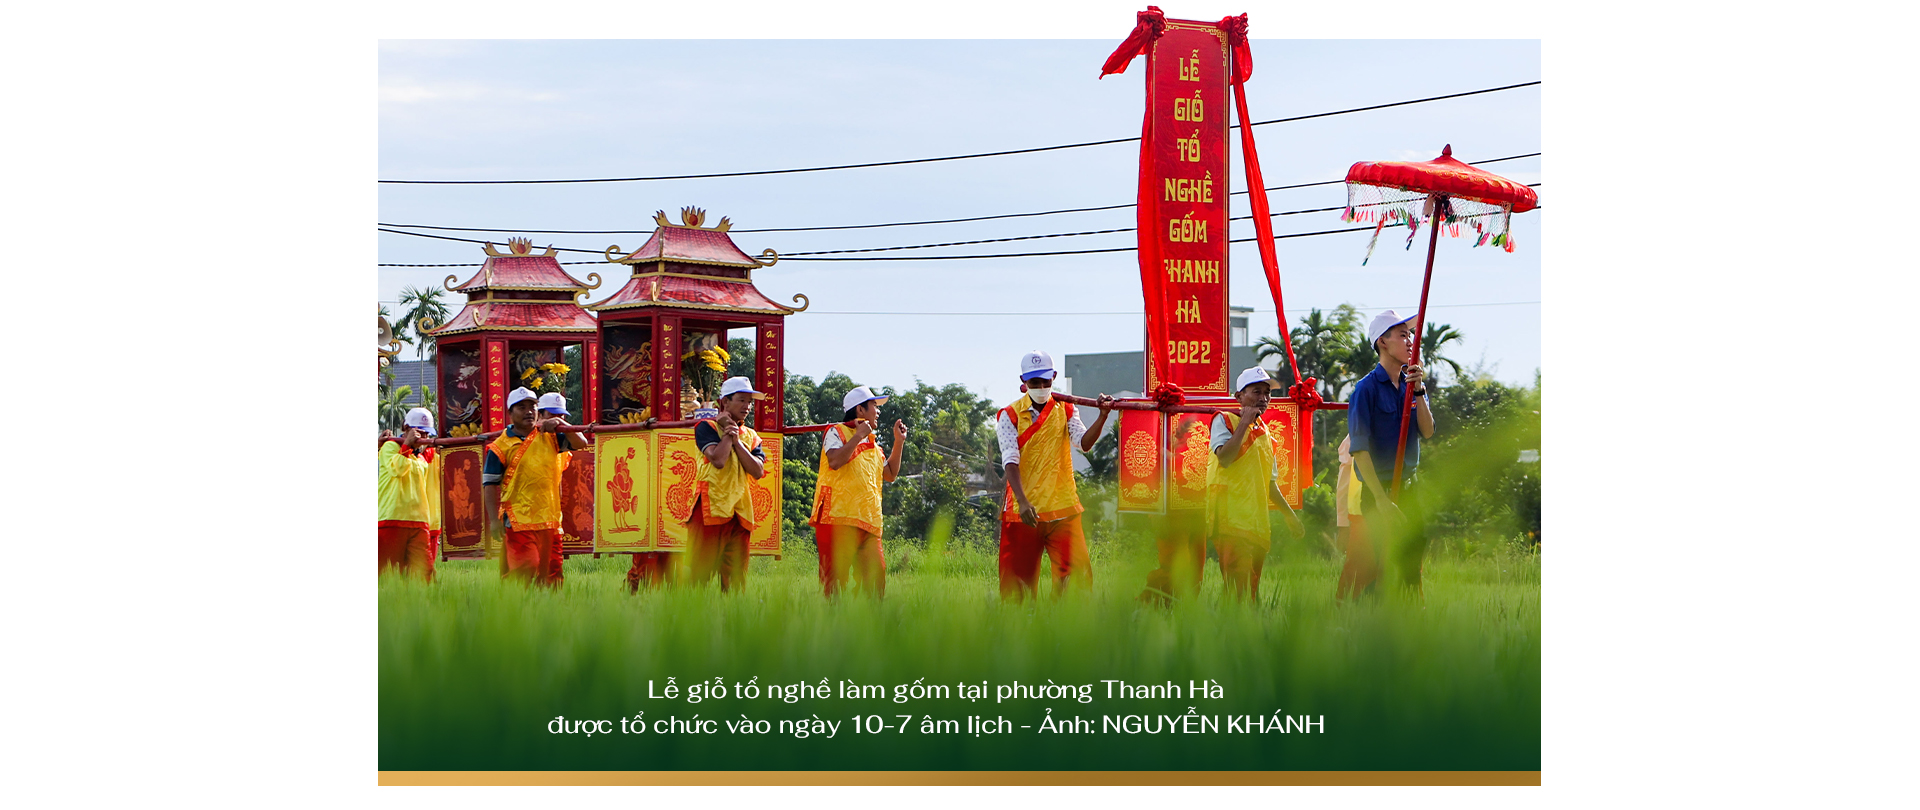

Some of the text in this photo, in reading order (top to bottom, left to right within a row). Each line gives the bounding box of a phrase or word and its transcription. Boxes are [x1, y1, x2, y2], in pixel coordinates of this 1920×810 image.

[1178, 48, 1201, 82] LỄ
[1174, 89, 1204, 123] GIỖ
[1176, 129, 1201, 163] TỔ
[1164, 170, 1213, 204] NGHỀ
[1169, 211, 1208, 243] GỐM
[1175, 294, 1202, 324] HÀ
[1168, 340, 1211, 364] 2022
